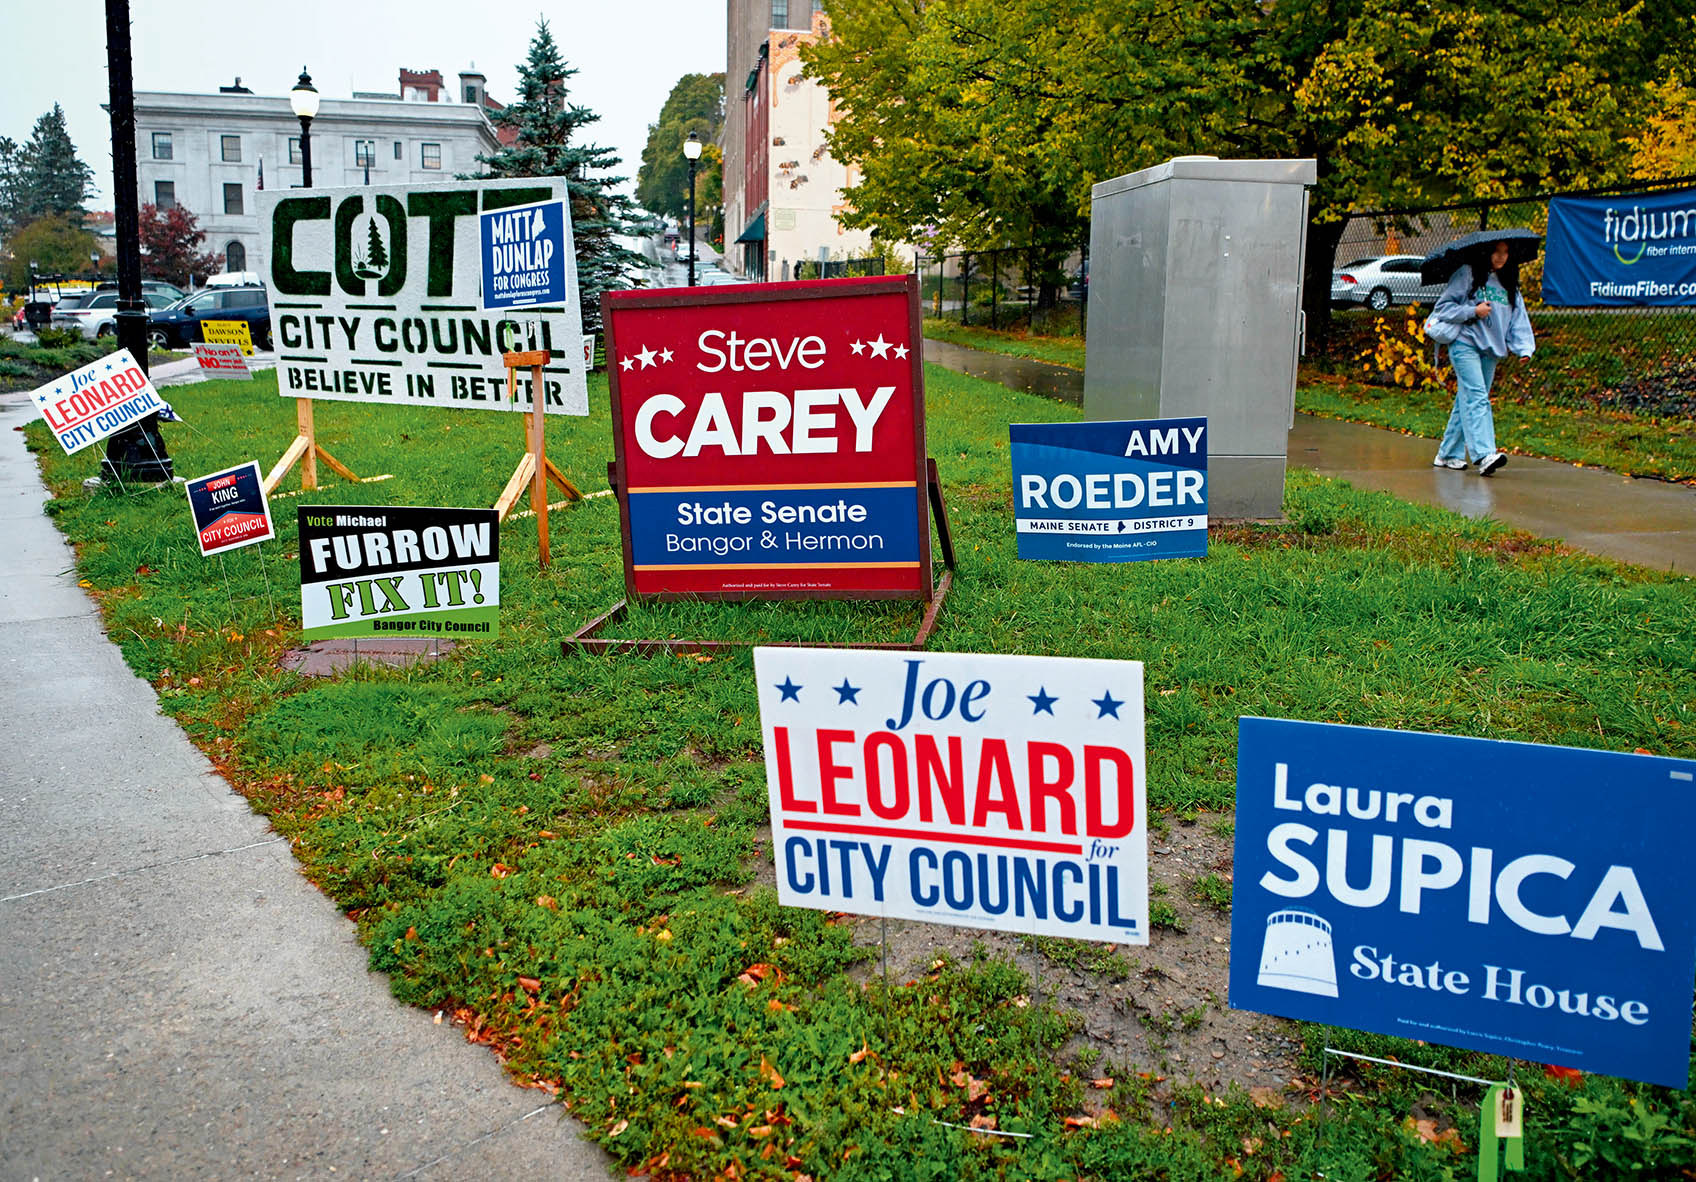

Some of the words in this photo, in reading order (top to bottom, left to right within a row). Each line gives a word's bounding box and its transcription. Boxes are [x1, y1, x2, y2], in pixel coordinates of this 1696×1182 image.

[271, 187, 552, 297] COT
[492, 210, 532, 245] MATT
[1604, 206, 1696, 243] fidium
[492, 239, 554, 275] DUNLAP
[1647, 247, 1667, 257] fiber
[494, 275, 509, 291] FOR
[510, 270, 550, 289] CONGRESS
[280, 315, 361, 350] CITY
[374, 318, 565, 358] COUNCIL
[696, 329, 827, 373] Steve
[43, 367, 147, 430] LEONARD
[71, 369, 97, 394] Joe
[288, 368, 392, 395] BELIEVE
[407, 374, 435, 398] IN
[60, 421, 96, 450] CITY
[95, 393, 160, 432] COUNCIL
[634, 386, 897, 459] CAREY
[1124, 426, 1205, 457] AMY
[211, 486, 239, 504] KING
[213, 478, 231, 490] JOHN
[1020, 470, 1205, 509] ROEDER
[202, 528, 222, 543] CITY
[223, 517, 265, 537] COUNCIL
[306, 515, 333, 527] Vote
[336, 515, 387, 527] Michael
[677, 502, 752, 526] State
[761, 500, 868, 524] Senate
[1030, 521, 1065, 531] MAINE
[1068, 522, 1110, 532] SENATE
[1133, 518, 1183, 530] DISTRICT
[1187, 518, 1194, 527] 9
[309, 522, 490, 573] FURROW
[666, 533, 753, 556] Bangor
[760, 530, 779, 550] &
[785, 532, 884, 550] Hermon
[326, 575, 410, 620] FIX
[418, 568, 485, 609] IT!
[373, 620, 416, 632] Bangor
[419, 619, 442, 632] City
[445, 620, 490, 633] Council
[885, 659, 992, 732] Joe
[774, 726, 1135, 839] LEONARD
[1274, 762, 1453, 829] Laura
[1086, 838, 1120, 862] for
[785, 836, 892, 902] CITY
[909, 847, 1137, 929] COUNCIL
[1259, 823, 1665, 952] SUPICA
[1350, 945, 1470, 995] State
[1482, 964, 1649, 1026] House
